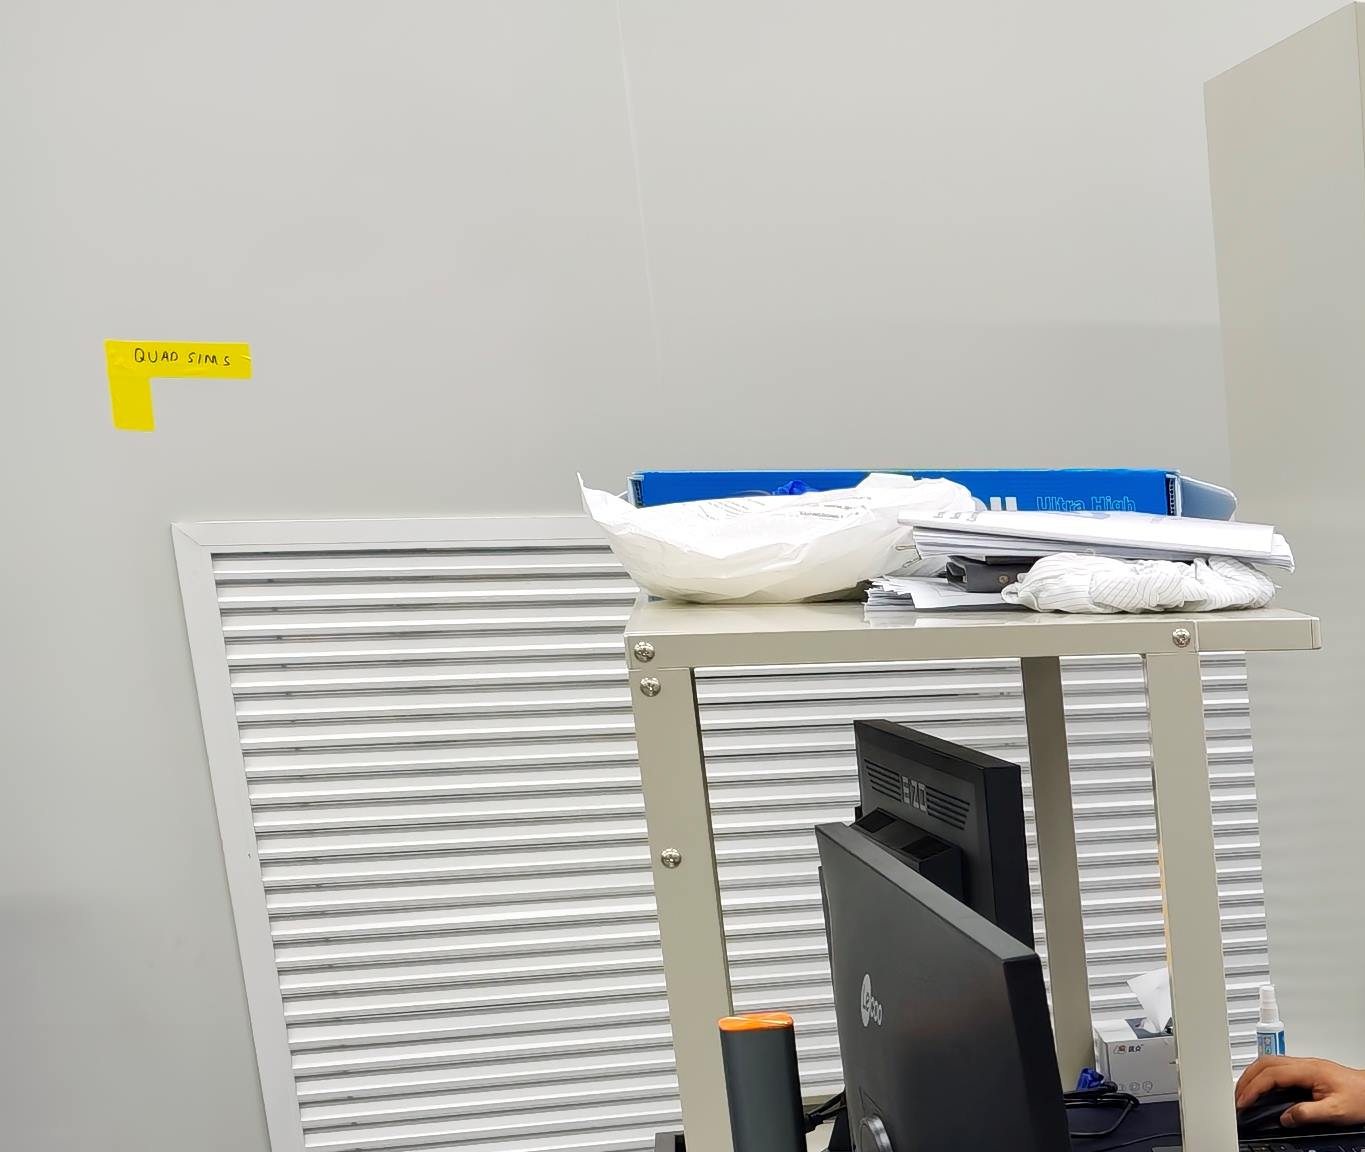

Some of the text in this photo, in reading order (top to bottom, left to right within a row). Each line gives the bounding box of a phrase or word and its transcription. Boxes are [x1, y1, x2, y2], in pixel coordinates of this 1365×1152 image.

[134, 347, 231, 367] QUAD SIMS
[1036, 496, 1086, 512] Ultra
[901, 775, 928, 813] EIZO
